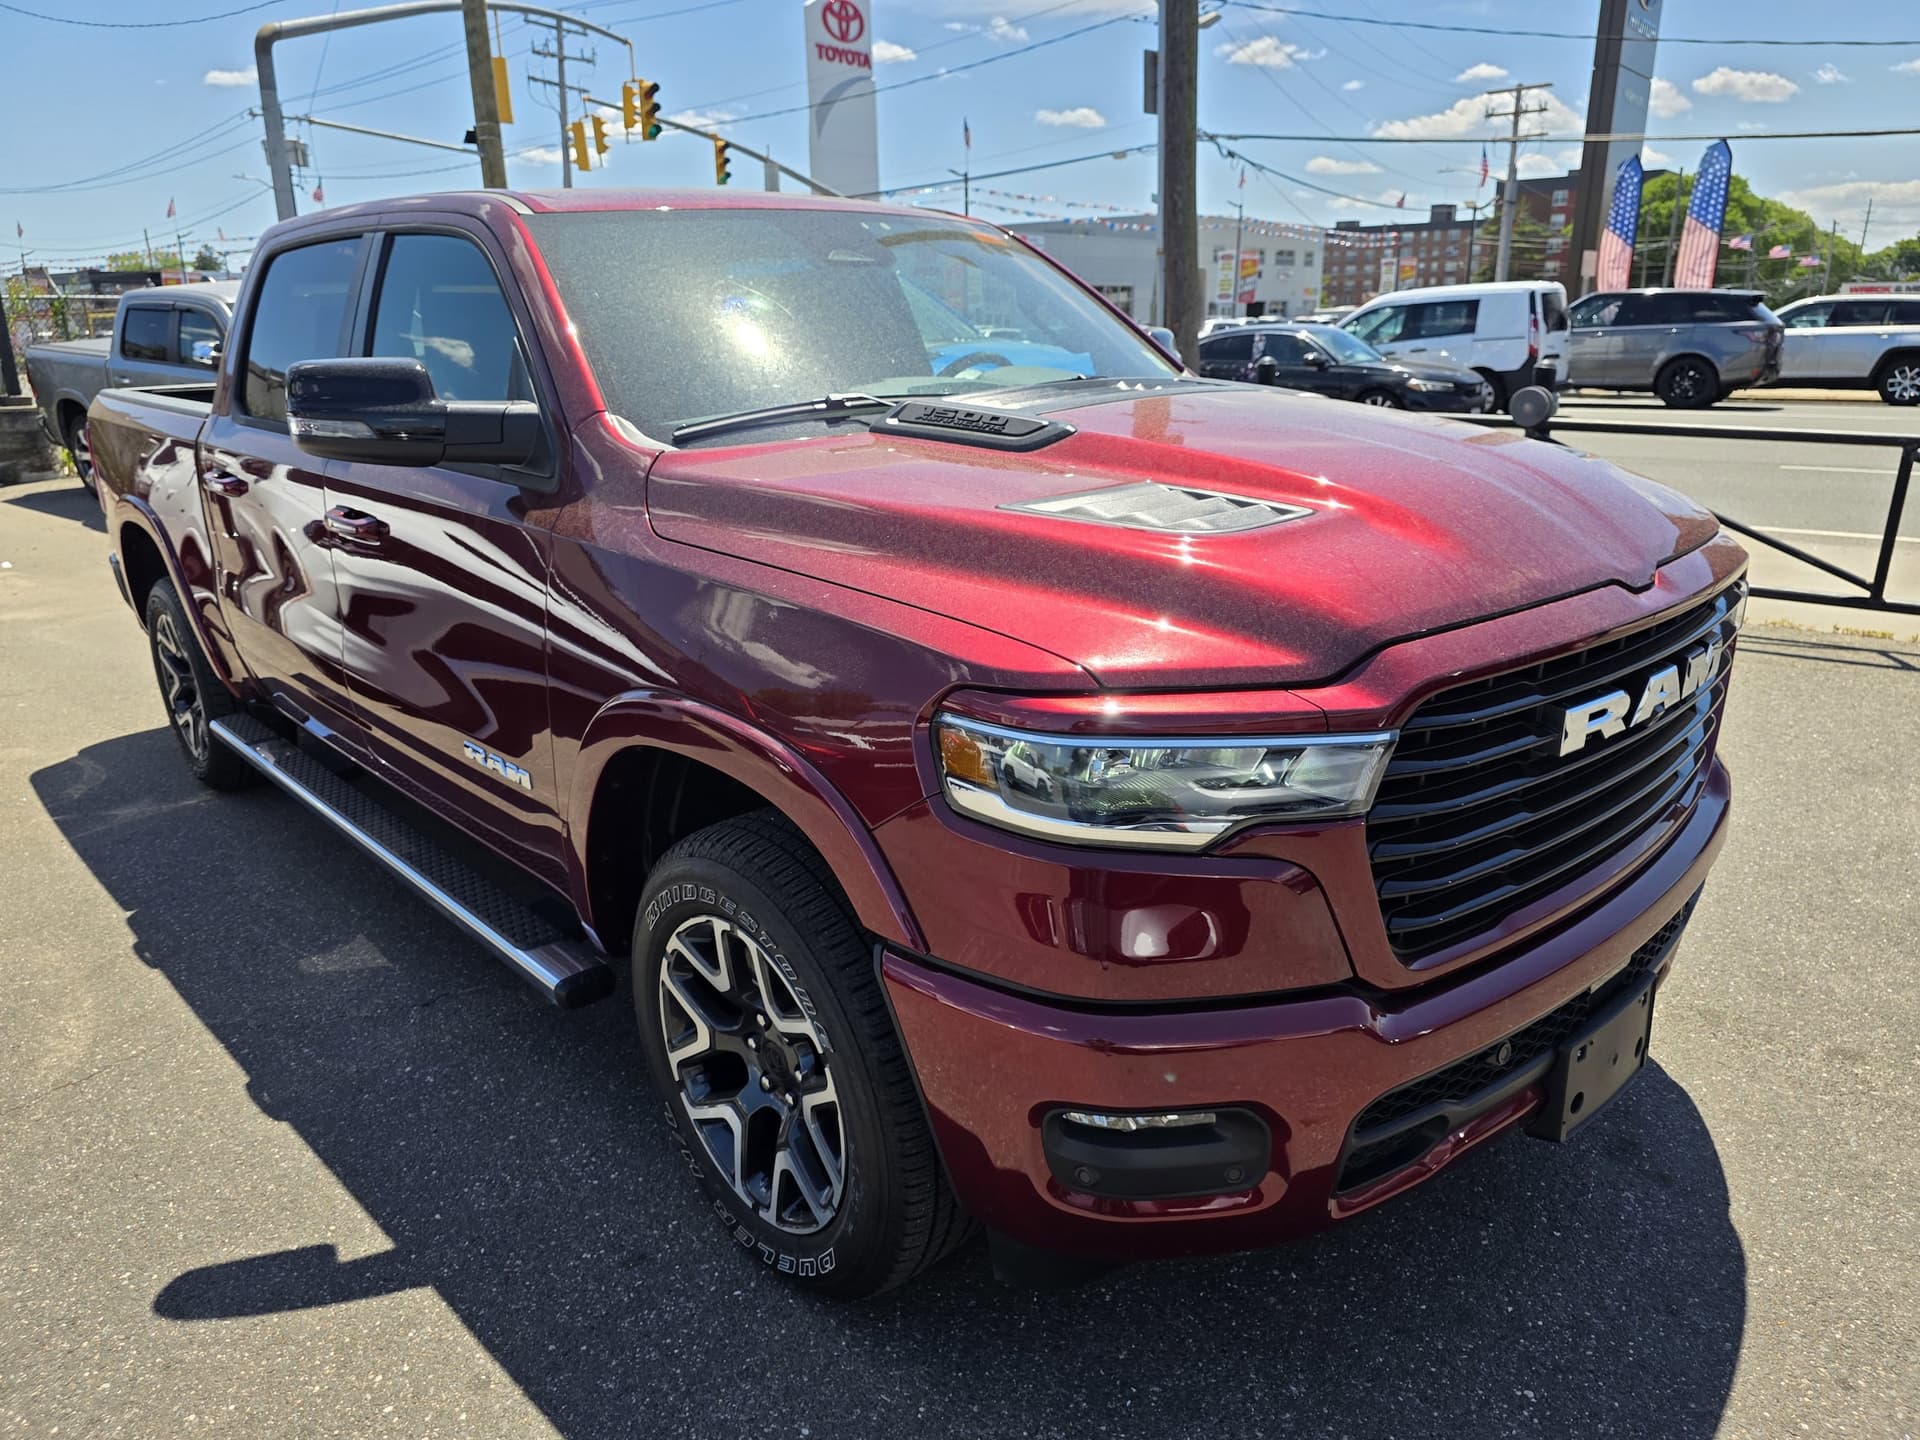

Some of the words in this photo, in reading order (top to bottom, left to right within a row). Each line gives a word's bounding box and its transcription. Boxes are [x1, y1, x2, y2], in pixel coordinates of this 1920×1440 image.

[815, 43, 872, 71] TOYOTA
[922, 406, 1009, 426] 1500
[1559, 633, 1723, 757] RAM
[463, 740, 533, 790] RAM
[645, 884, 834, 1053] BRIDGESTONE
[713, 1200, 836, 1277] DUELER
